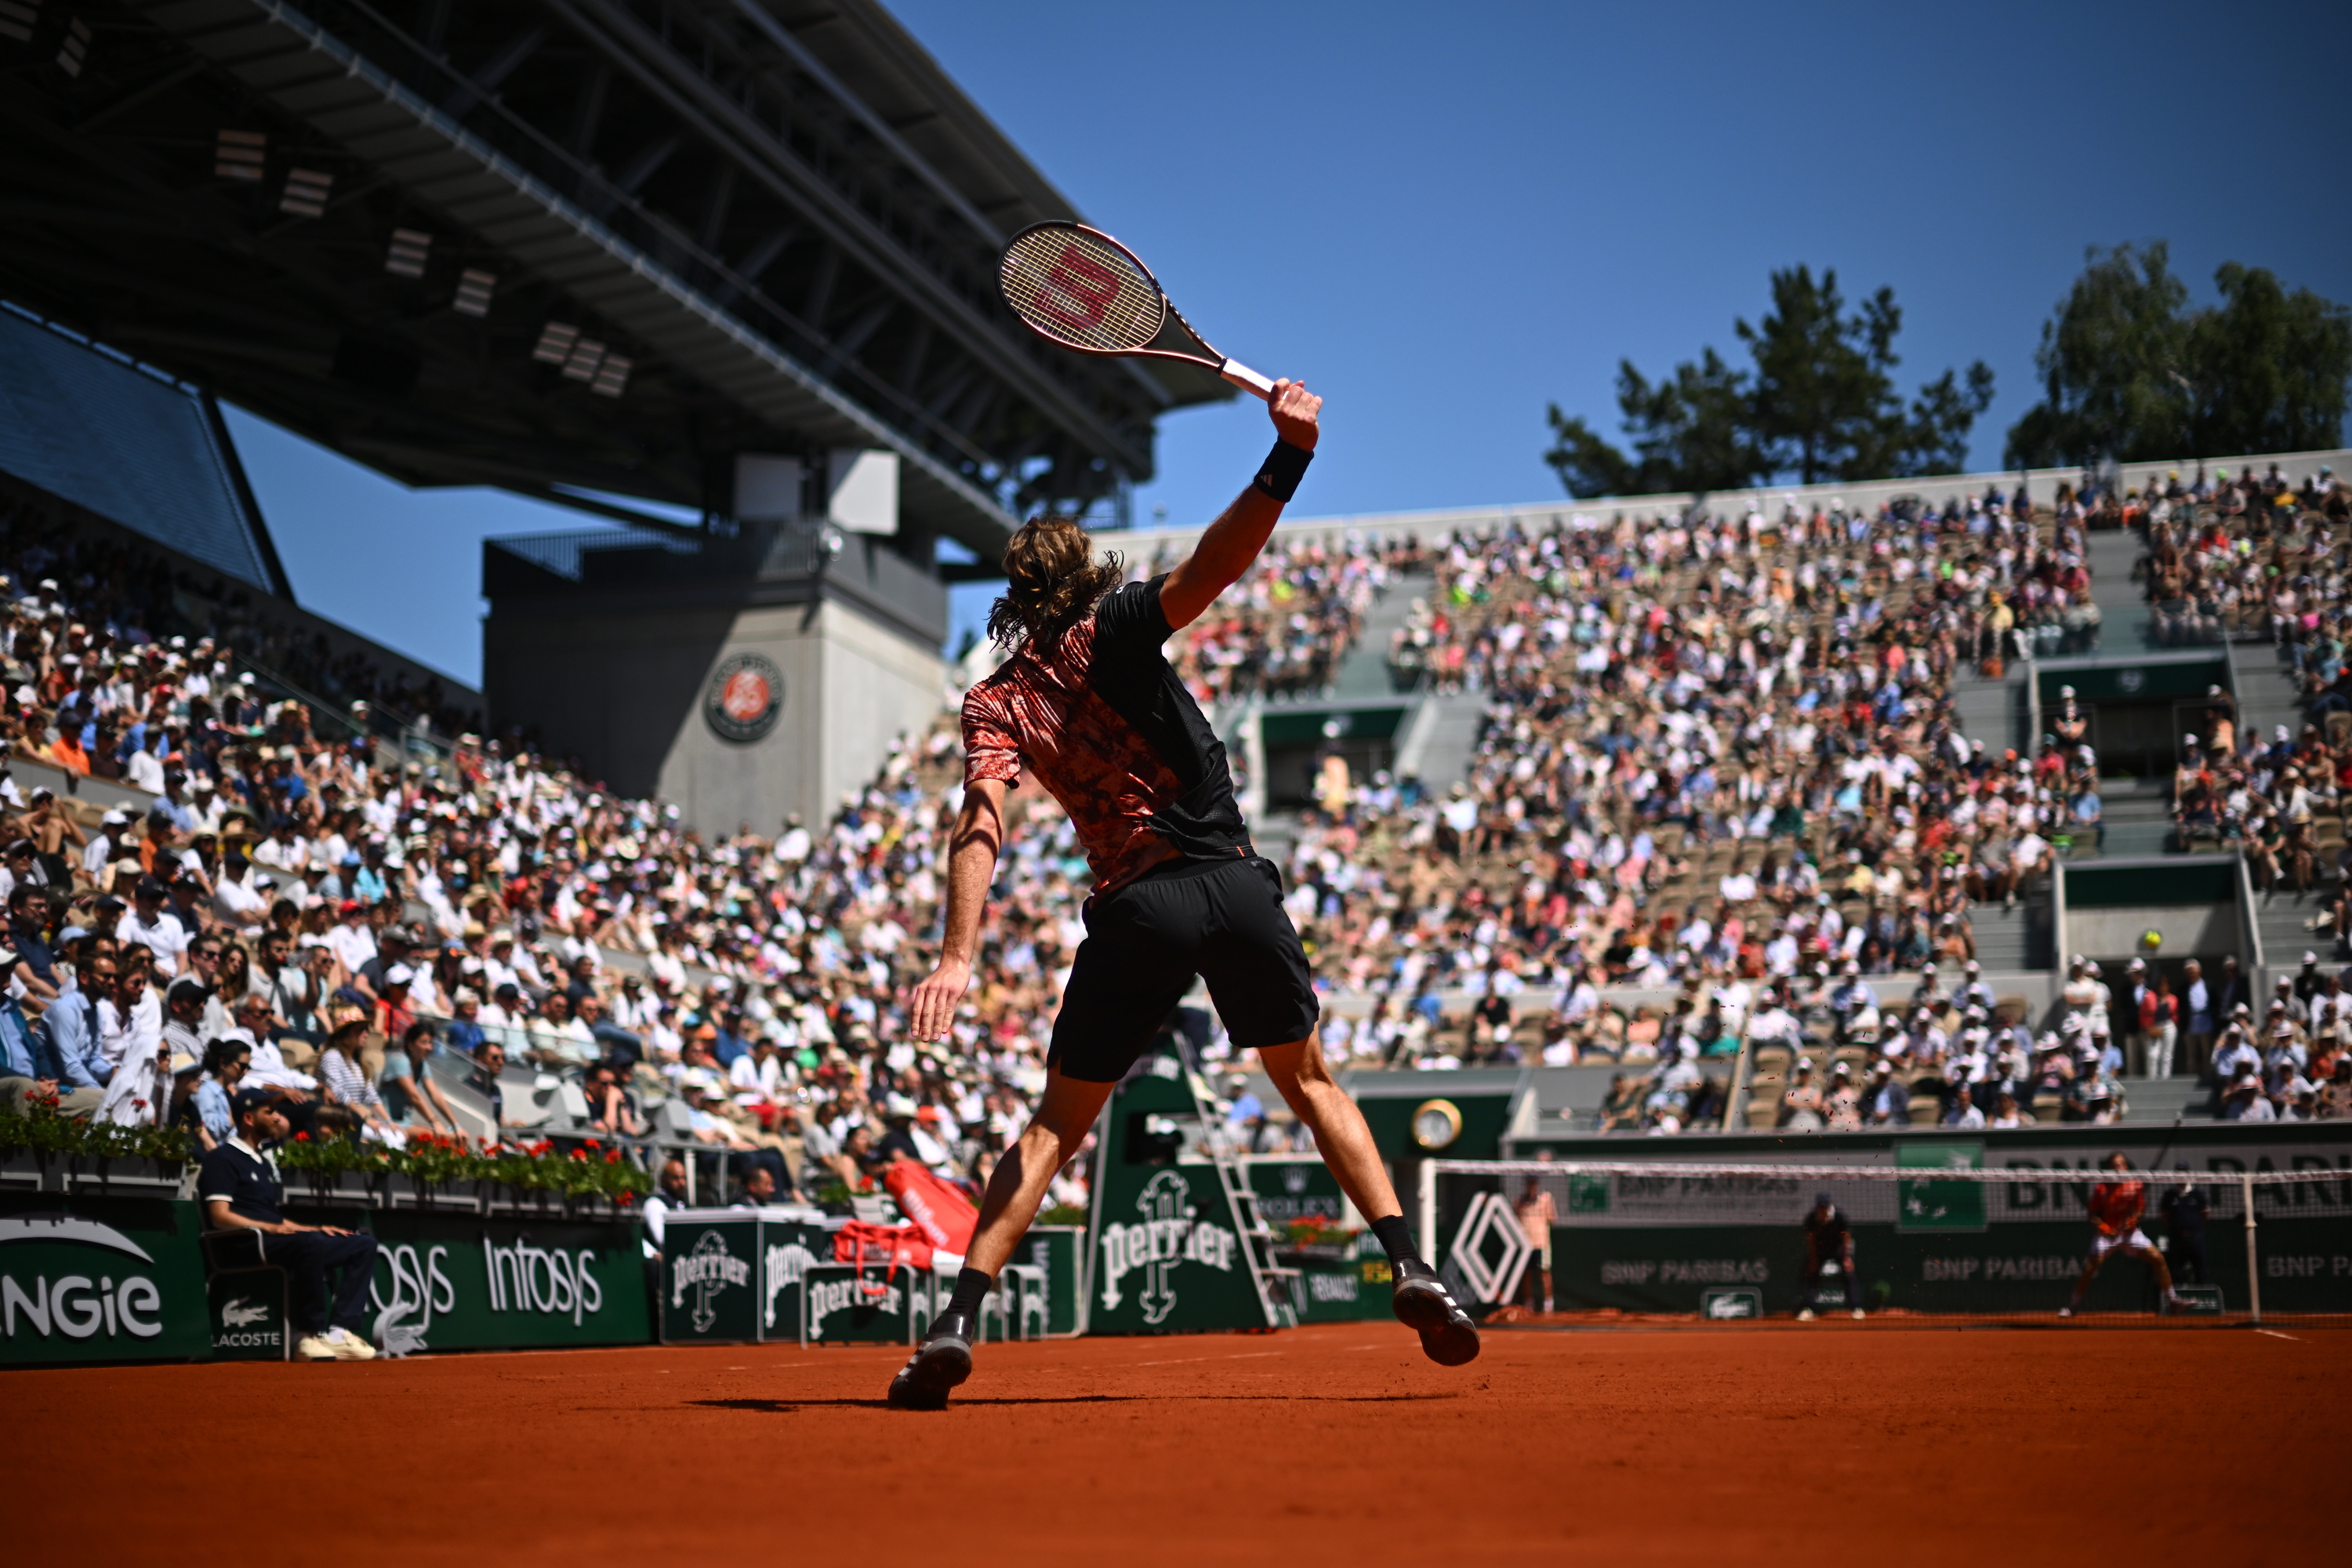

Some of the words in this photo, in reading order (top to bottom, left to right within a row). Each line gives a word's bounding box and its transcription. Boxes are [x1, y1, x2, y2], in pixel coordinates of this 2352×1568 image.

[1100, 1205, 1237, 1311] perrier
[1923, 1258, 1979, 1280] BNP
[2267, 1256, 2325, 1277] BNP
[2333, 1256, 2352, 1277] P
[483, 1231, 603, 1327] Infosys
[1602, 1261, 1656, 1284] BNP
[1659, 1259, 1770, 1283] PARIBAS
